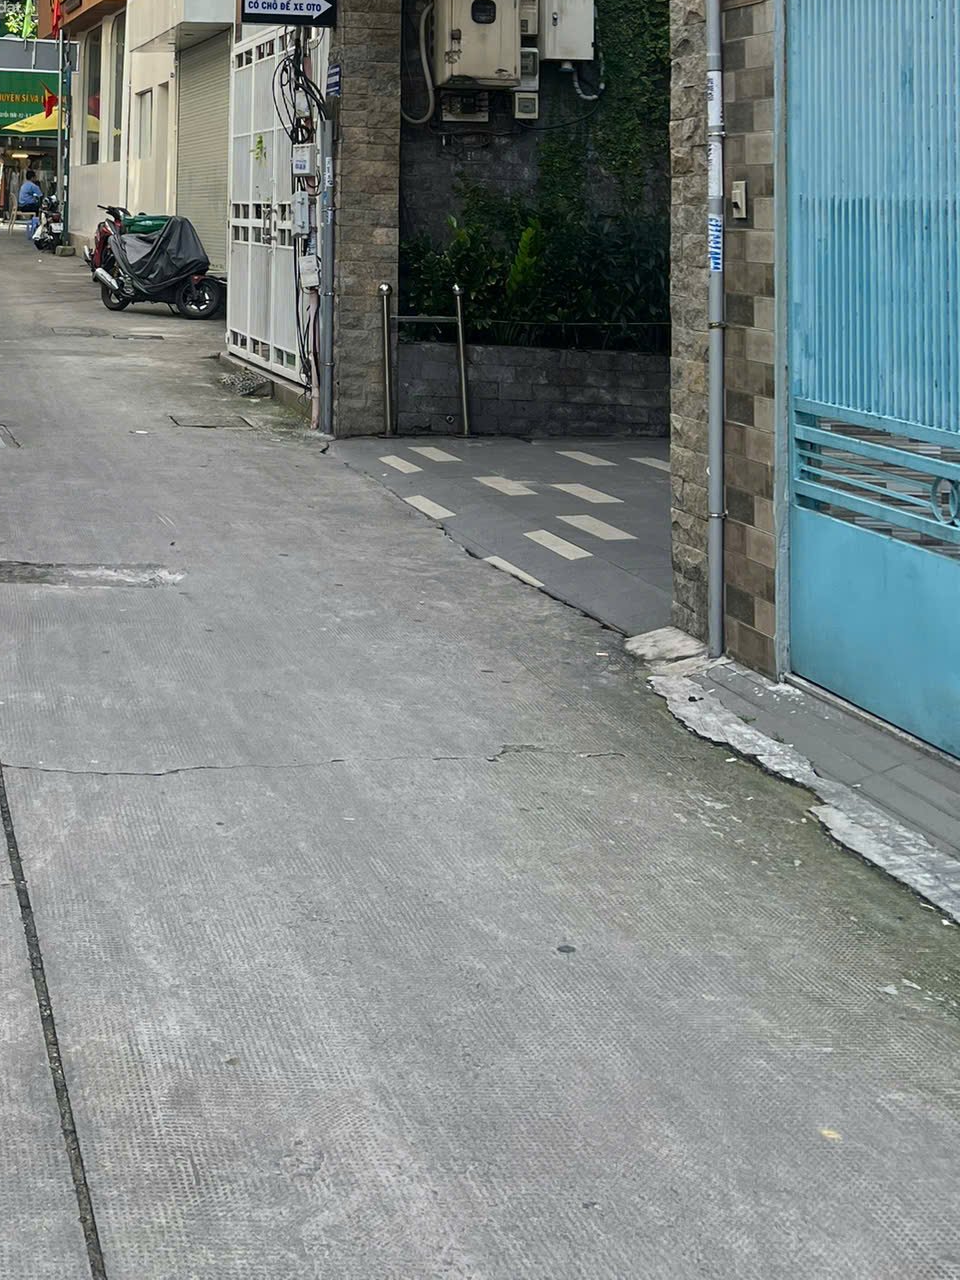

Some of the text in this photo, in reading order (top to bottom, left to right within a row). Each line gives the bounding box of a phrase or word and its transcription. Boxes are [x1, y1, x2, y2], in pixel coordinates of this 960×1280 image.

[248, 0, 259, 9] CÓ
[293, 2, 304, 12] XE
[306, 3, 322, 12] OTO
